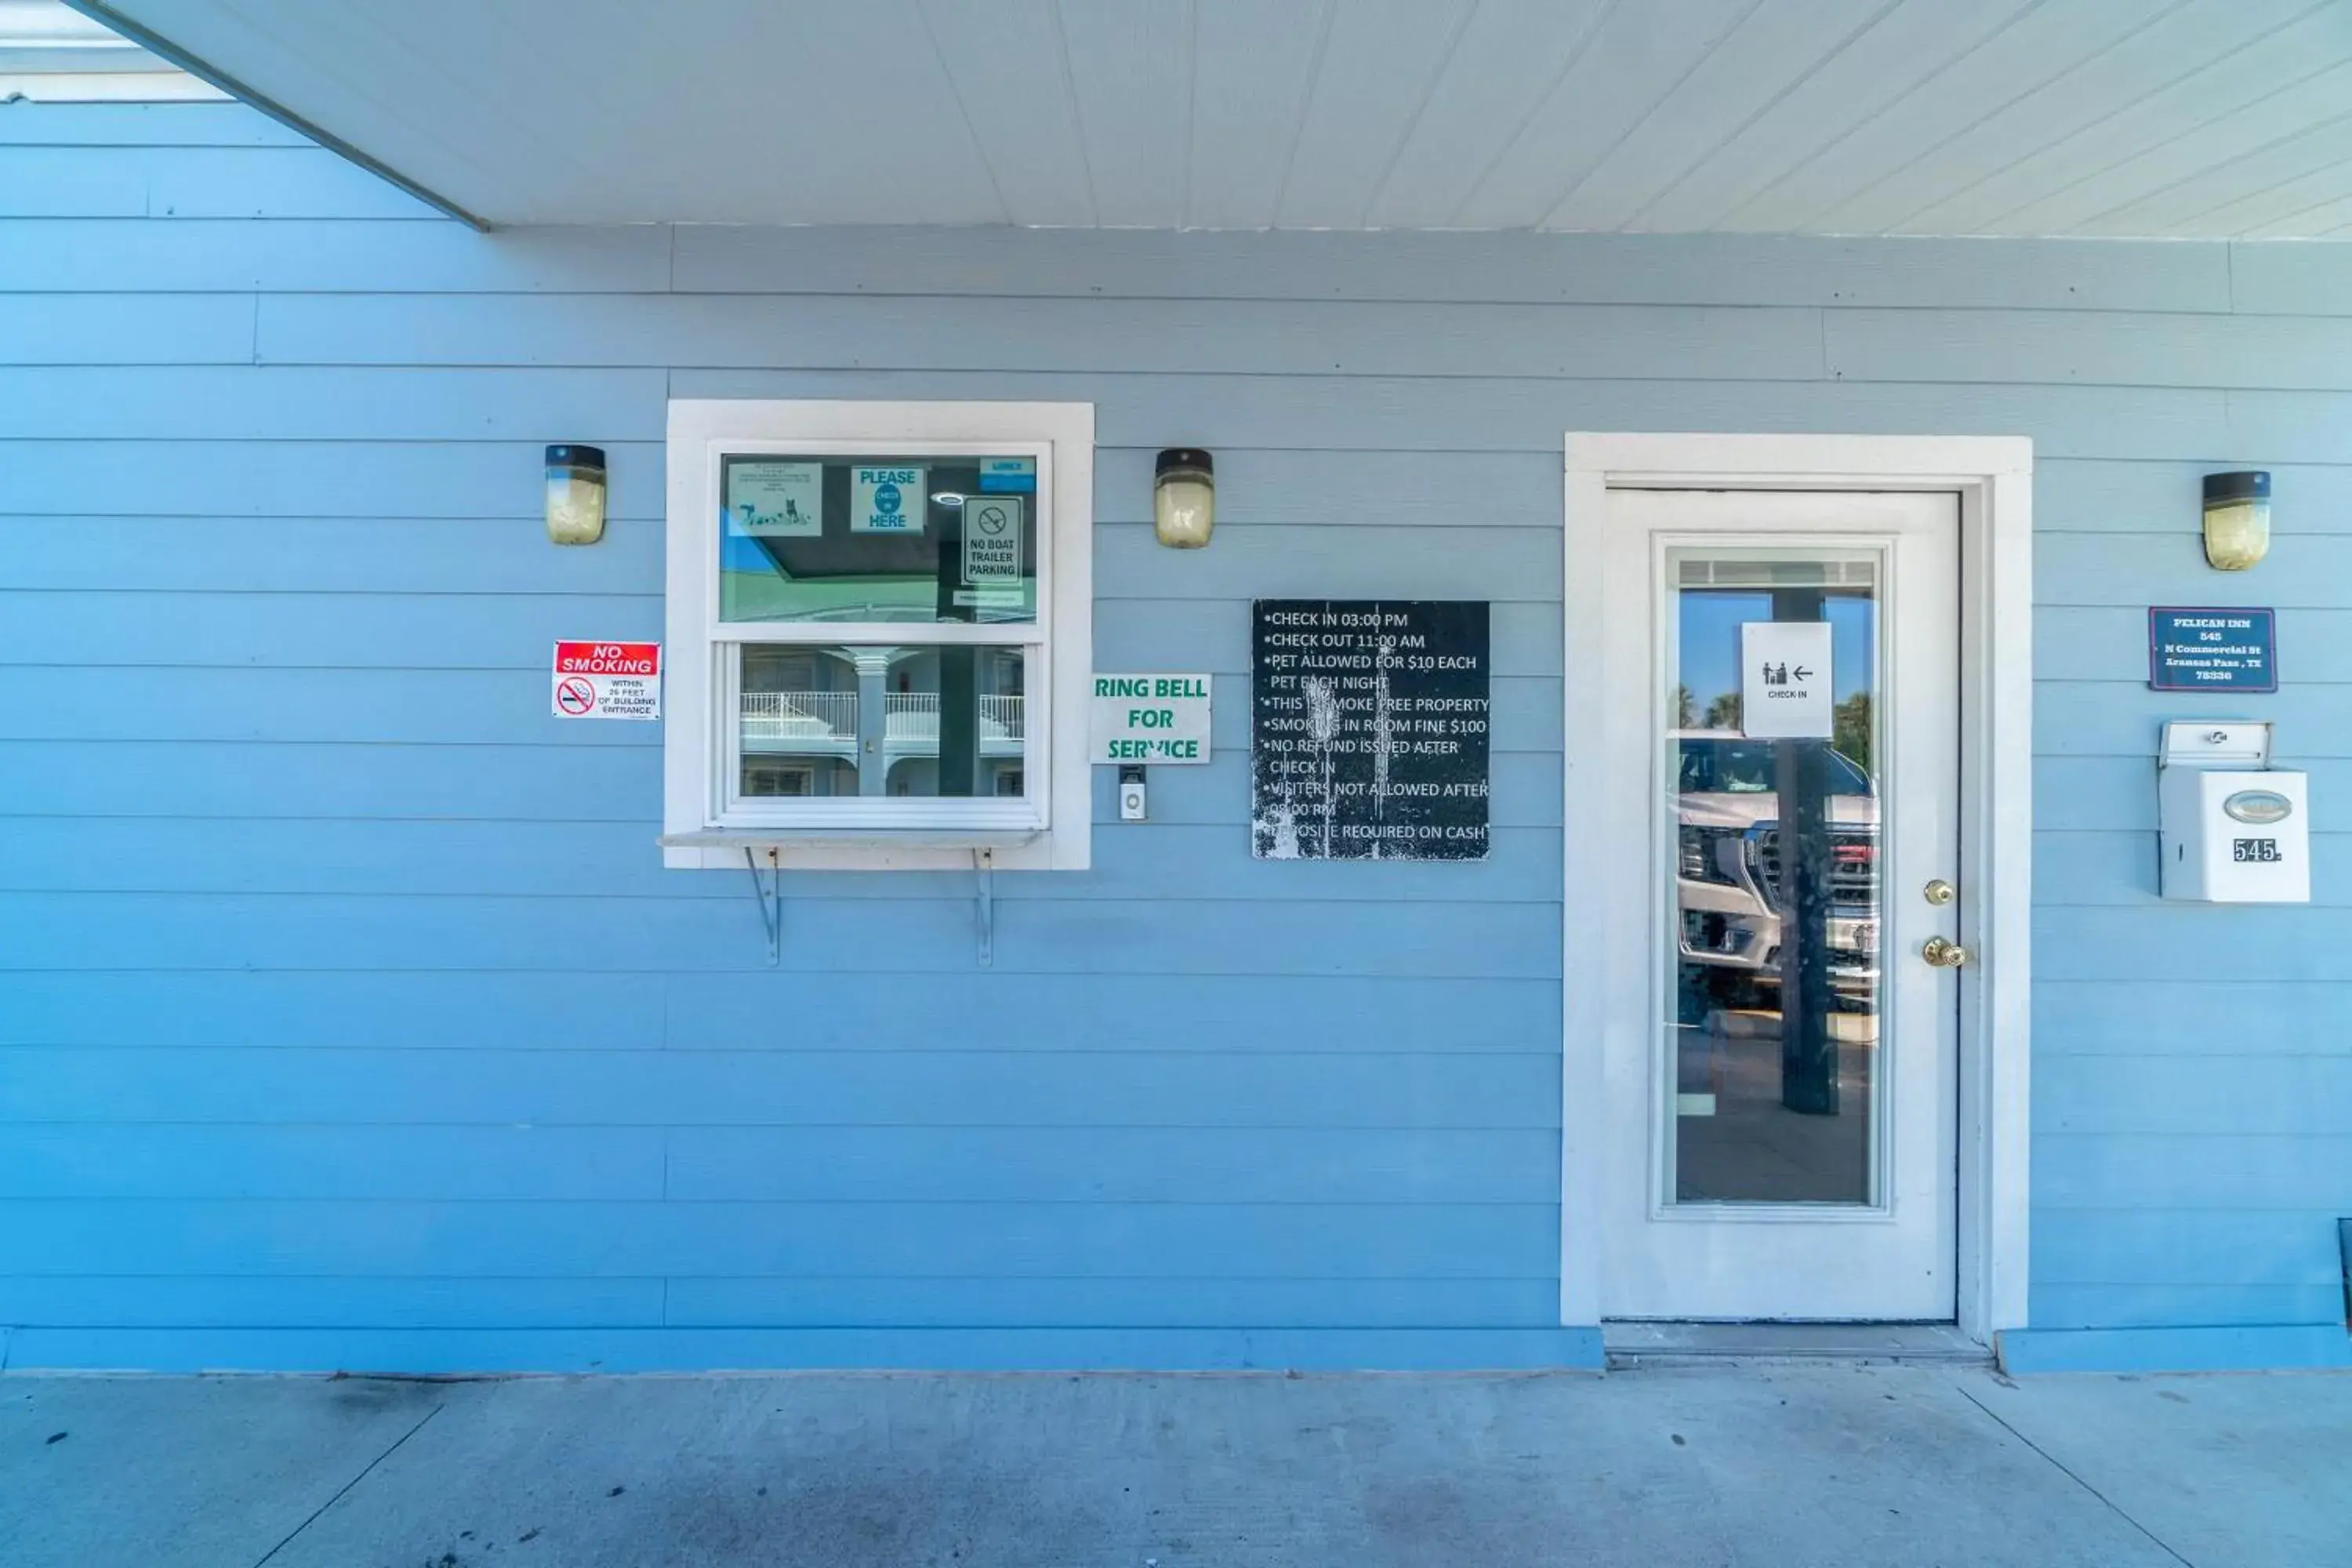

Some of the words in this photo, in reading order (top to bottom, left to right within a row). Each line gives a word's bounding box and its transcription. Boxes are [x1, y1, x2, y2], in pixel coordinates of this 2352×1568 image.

[860, 470, 916, 484] PLEASE
[869, 514, 907, 528] HERE
[970, 539, 985, 550] NO
[988, 539, 1014, 550] BOAT
[971, 552, 1014, 562] TRAILER
[969, 564, 1017, 575] PARKING
[1272, 612, 1319, 626] CHECK
[1323, 613, 1338, 626] IN
[1341, 614, 1381, 626] 03:00
[1385, 614, 1408, 627] PM
[2173, 618, 2225, 628] PELICAN
[2227, 619, 2251, 628] INN
[1272, 633, 1319, 647] CHECK
[1322, 634, 1354, 647] OUT
[1358, 635, 1396, 648] 11:00
[1399, 635, 1425, 648] AM
[2200, 632, 2223, 641] 545
[593, 645, 622, 659] NO
[2165, 644, 2174, 653] N
[2176, 645, 2247, 655] Commercial
[2249, 646, 2262, 655] St
[562, 658, 652, 673] SMOKING
[1272, 655, 1298, 667] PET
[1301, 655, 1372, 669] ALLOWED
[1376, 655, 1405, 669] FOR
[1408, 655, 1435, 670] $10
[1439, 656, 1476, 669] EACH
[2165, 658, 2212, 666] Aransas
[2246, 659, 2262, 668] TX
[1095, 679, 1149, 697] RING
[1156, 679, 1208, 697] BELL
[1271, 675, 1298, 689] PET
[1301, 676, 1339, 689] EACH
[1343, 677, 1388, 690] NIGHT
[614, 698, 656, 706] BUILDING
[1271, 696, 1303, 710] THIS
[1323, 697, 1374, 711] MOKE
[1380, 699, 1412, 712] FREE
[1416, 699, 1489, 712] PROPERTY
[603, 706, 652, 714] ENTRANCE
[1128, 710, 1174, 728] FOR
[1271, 717, 1340, 731] SMOKG
[1345, 719, 1359, 731] IN
[1364, 719, 1411, 732] ROOM
[1415, 720, 1446, 733] FINE
[1450, 718, 1486, 735] $100
[1108, 740, 1198, 759] SERVICE
[1271, 739, 1294, 752] NO
[1298, 739, 1356, 753] REFUND
[1360, 739, 1410, 753] ISSUED
[1414, 741, 1459, 755] AFTER
[1270, 760, 1316, 774] CHECK
[1320, 761, 1336, 774] IN
[1335, 783, 1365, 796] NOT
[1369, 783, 1439, 797] ALLOWED
[1444, 784, 1489, 797] AFTER
[1313, 804, 1336, 815] PM
[1271, 824, 1339, 838] OSITE
[1343, 825, 1414, 839] REQUIRED
[1419, 826, 1442, 839] ON
[1446, 826, 1485, 839] CASH
